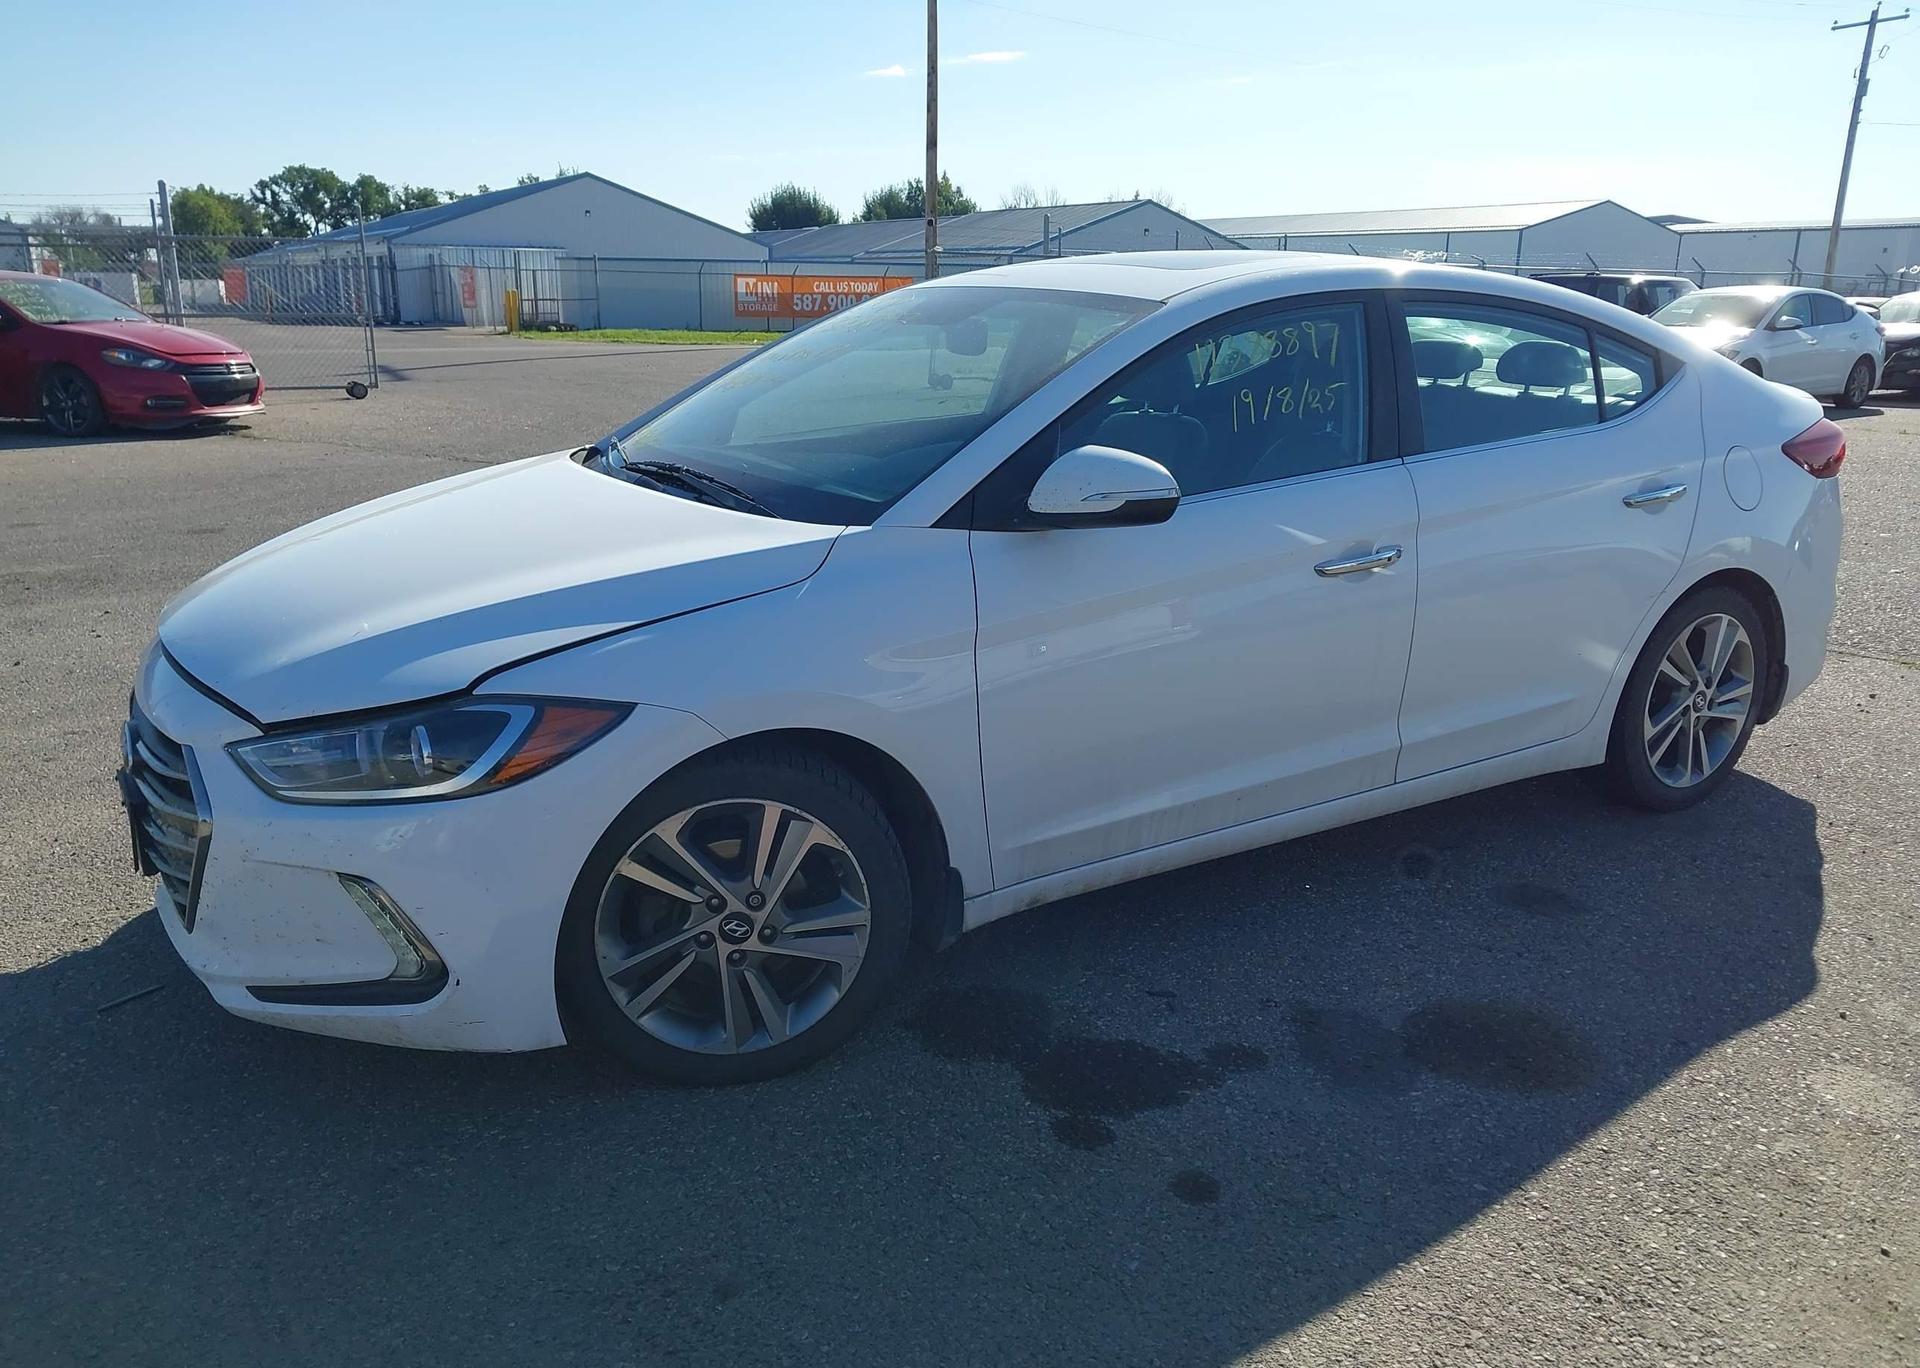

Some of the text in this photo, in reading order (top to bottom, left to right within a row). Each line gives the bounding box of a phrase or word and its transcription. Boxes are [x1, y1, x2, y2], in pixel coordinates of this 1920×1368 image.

[737, 278, 779, 300] MINI
[813, 281, 879, 293] CALL US TODAY
[737, 303, 779, 312] STORAGE
[793, 293, 871, 311] 587.900
